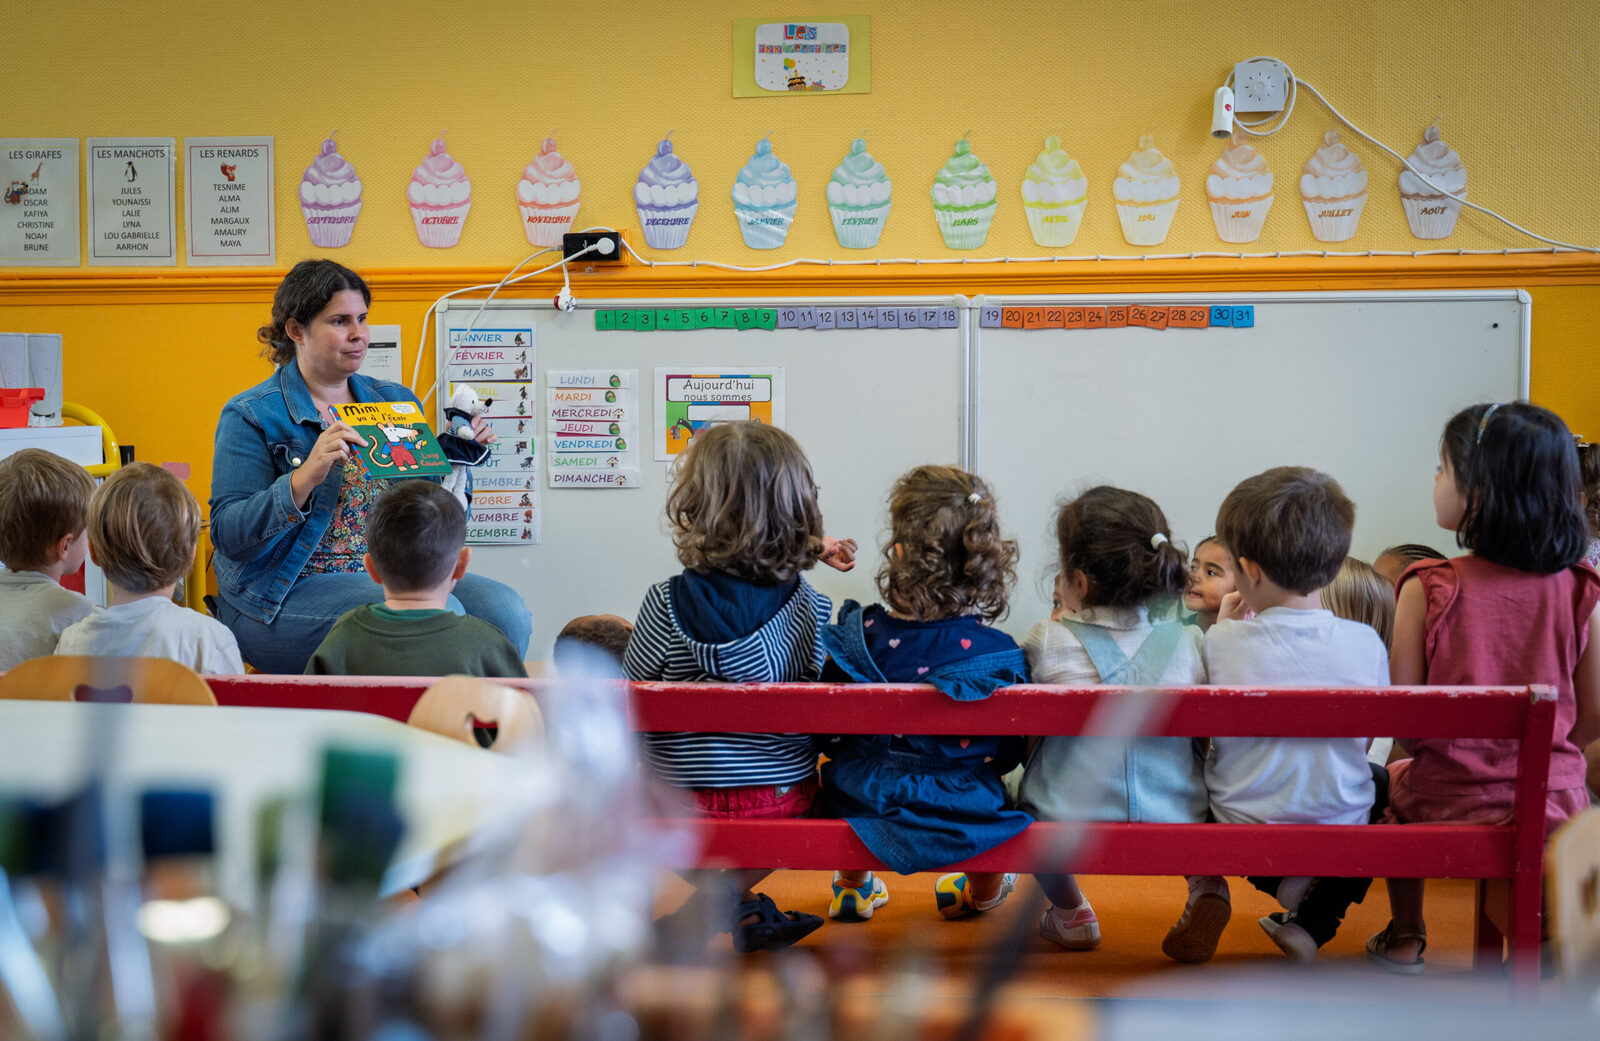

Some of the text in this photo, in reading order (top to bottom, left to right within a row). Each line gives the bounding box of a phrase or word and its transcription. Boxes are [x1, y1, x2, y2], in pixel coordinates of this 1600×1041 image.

[784, 25, 816, 40] Les
[759, 42, 846, 54] anniversaires
[9, 150, 62, 159] LES GIRAFES
[98, 150, 165, 158] LES MANCHOTS
[200, 149, 259, 158] LES RENARDS
[421, 216, 459, 225] OCTOBRE
[527, 215, 571, 224] NOVEMBRE
[952, 217, 979, 227] MARS
[603, 311, 956, 324] 1 2 3 4 5 6 7 8 9 10 11 12 13 14 15 16 17 18
[986, 308, 1250, 322] 19 20 21 22 23 24 25 26 27 28 29 30 31
[456, 350, 504, 360] FÉVRIER
[463, 368, 494, 377] MARS
[560, 376, 595, 384] LUNDI
[682, 380, 754, 392] Aujourd'hui
[474, 387, 498, 396] VRIL
[555, 393, 592, 401] MARDI
[552, 409, 612, 417] MERCREDI
[561, 424, 593, 432] JEUDI
[554, 440, 613, 449] VENDREDI
[554, 458, 597, 466] SAMEDI
[473, 478, 522, 486] TEMBRE
[554, 474, 614, 483] DIMANCHE
[472, 496, 512, 504] TOBRE
[471, 513, 519, 522] VEMBRE
[465, 526, 518, 538] ÉCEMBRE
